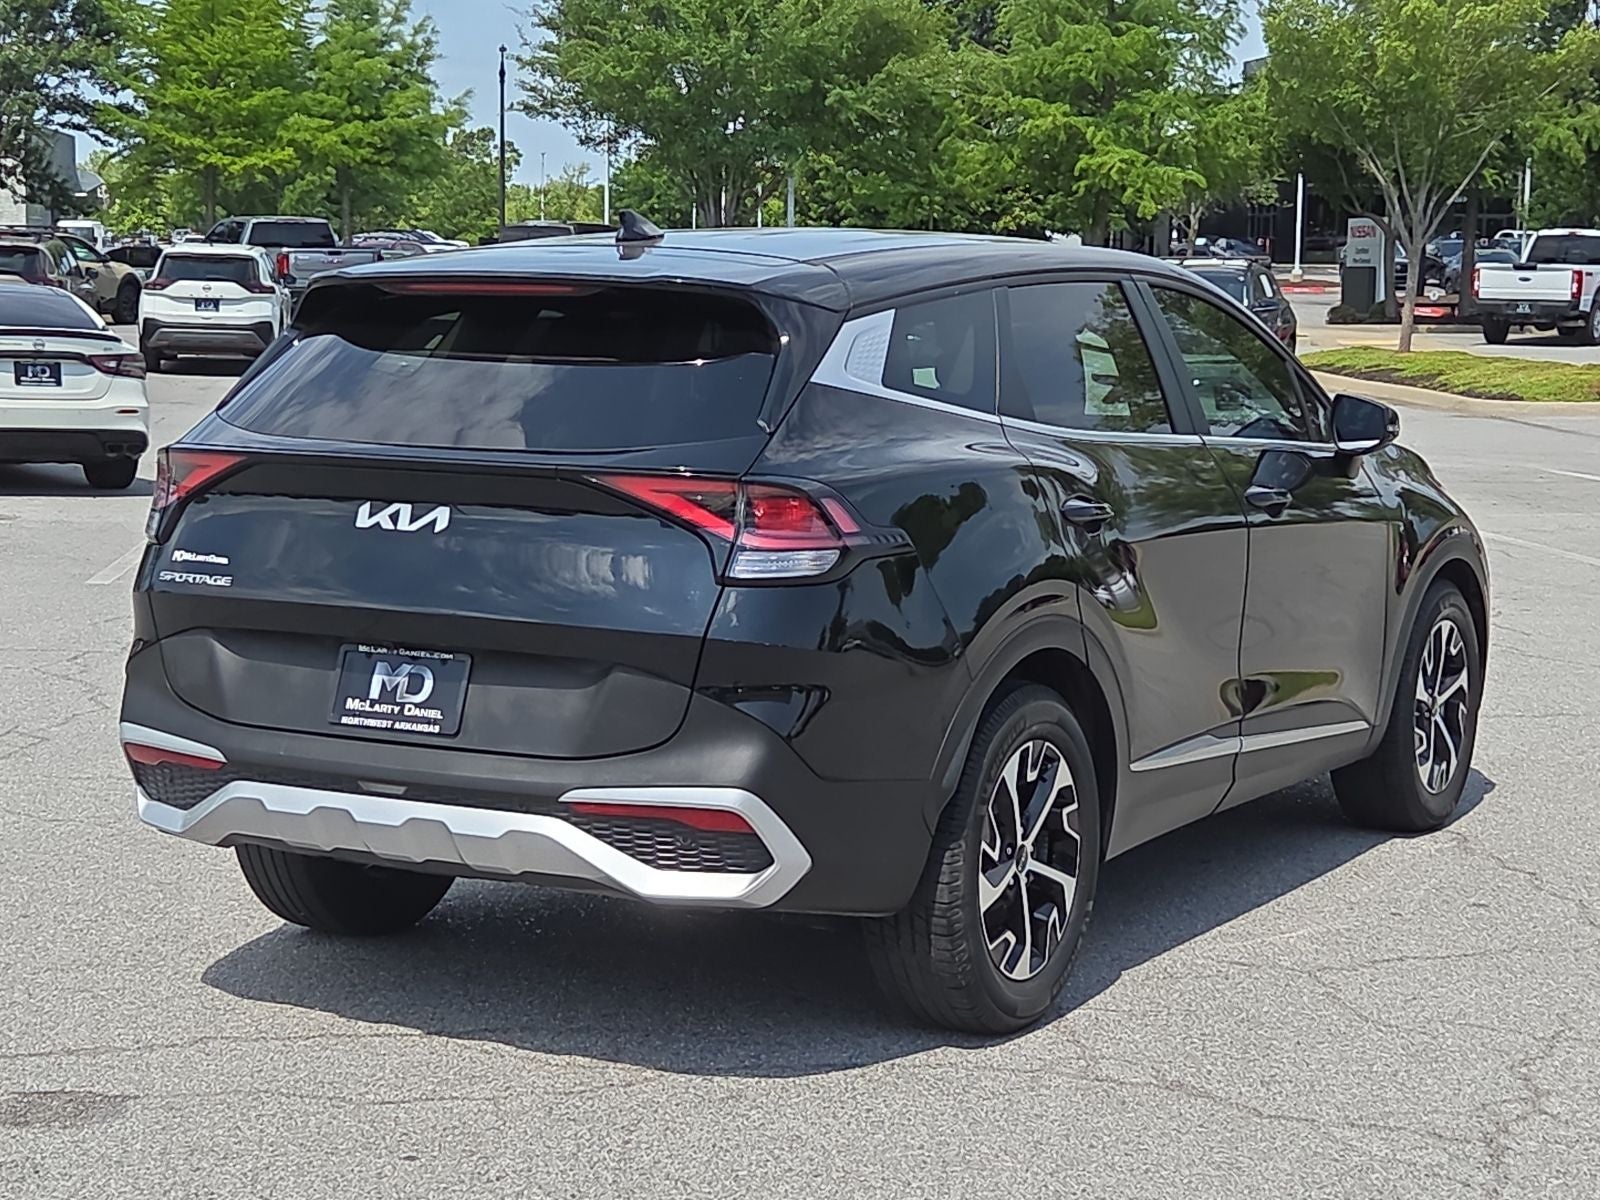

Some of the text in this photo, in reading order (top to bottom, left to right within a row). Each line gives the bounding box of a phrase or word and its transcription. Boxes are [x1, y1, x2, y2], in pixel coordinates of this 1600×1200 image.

[355, 500, 451, 534] KIA
[158, 571, 233, 587] SPORTAGE
[368, 661, 434, 704] MD
[340, 716, 440, 733] NORTHWEST ARKANSAS
